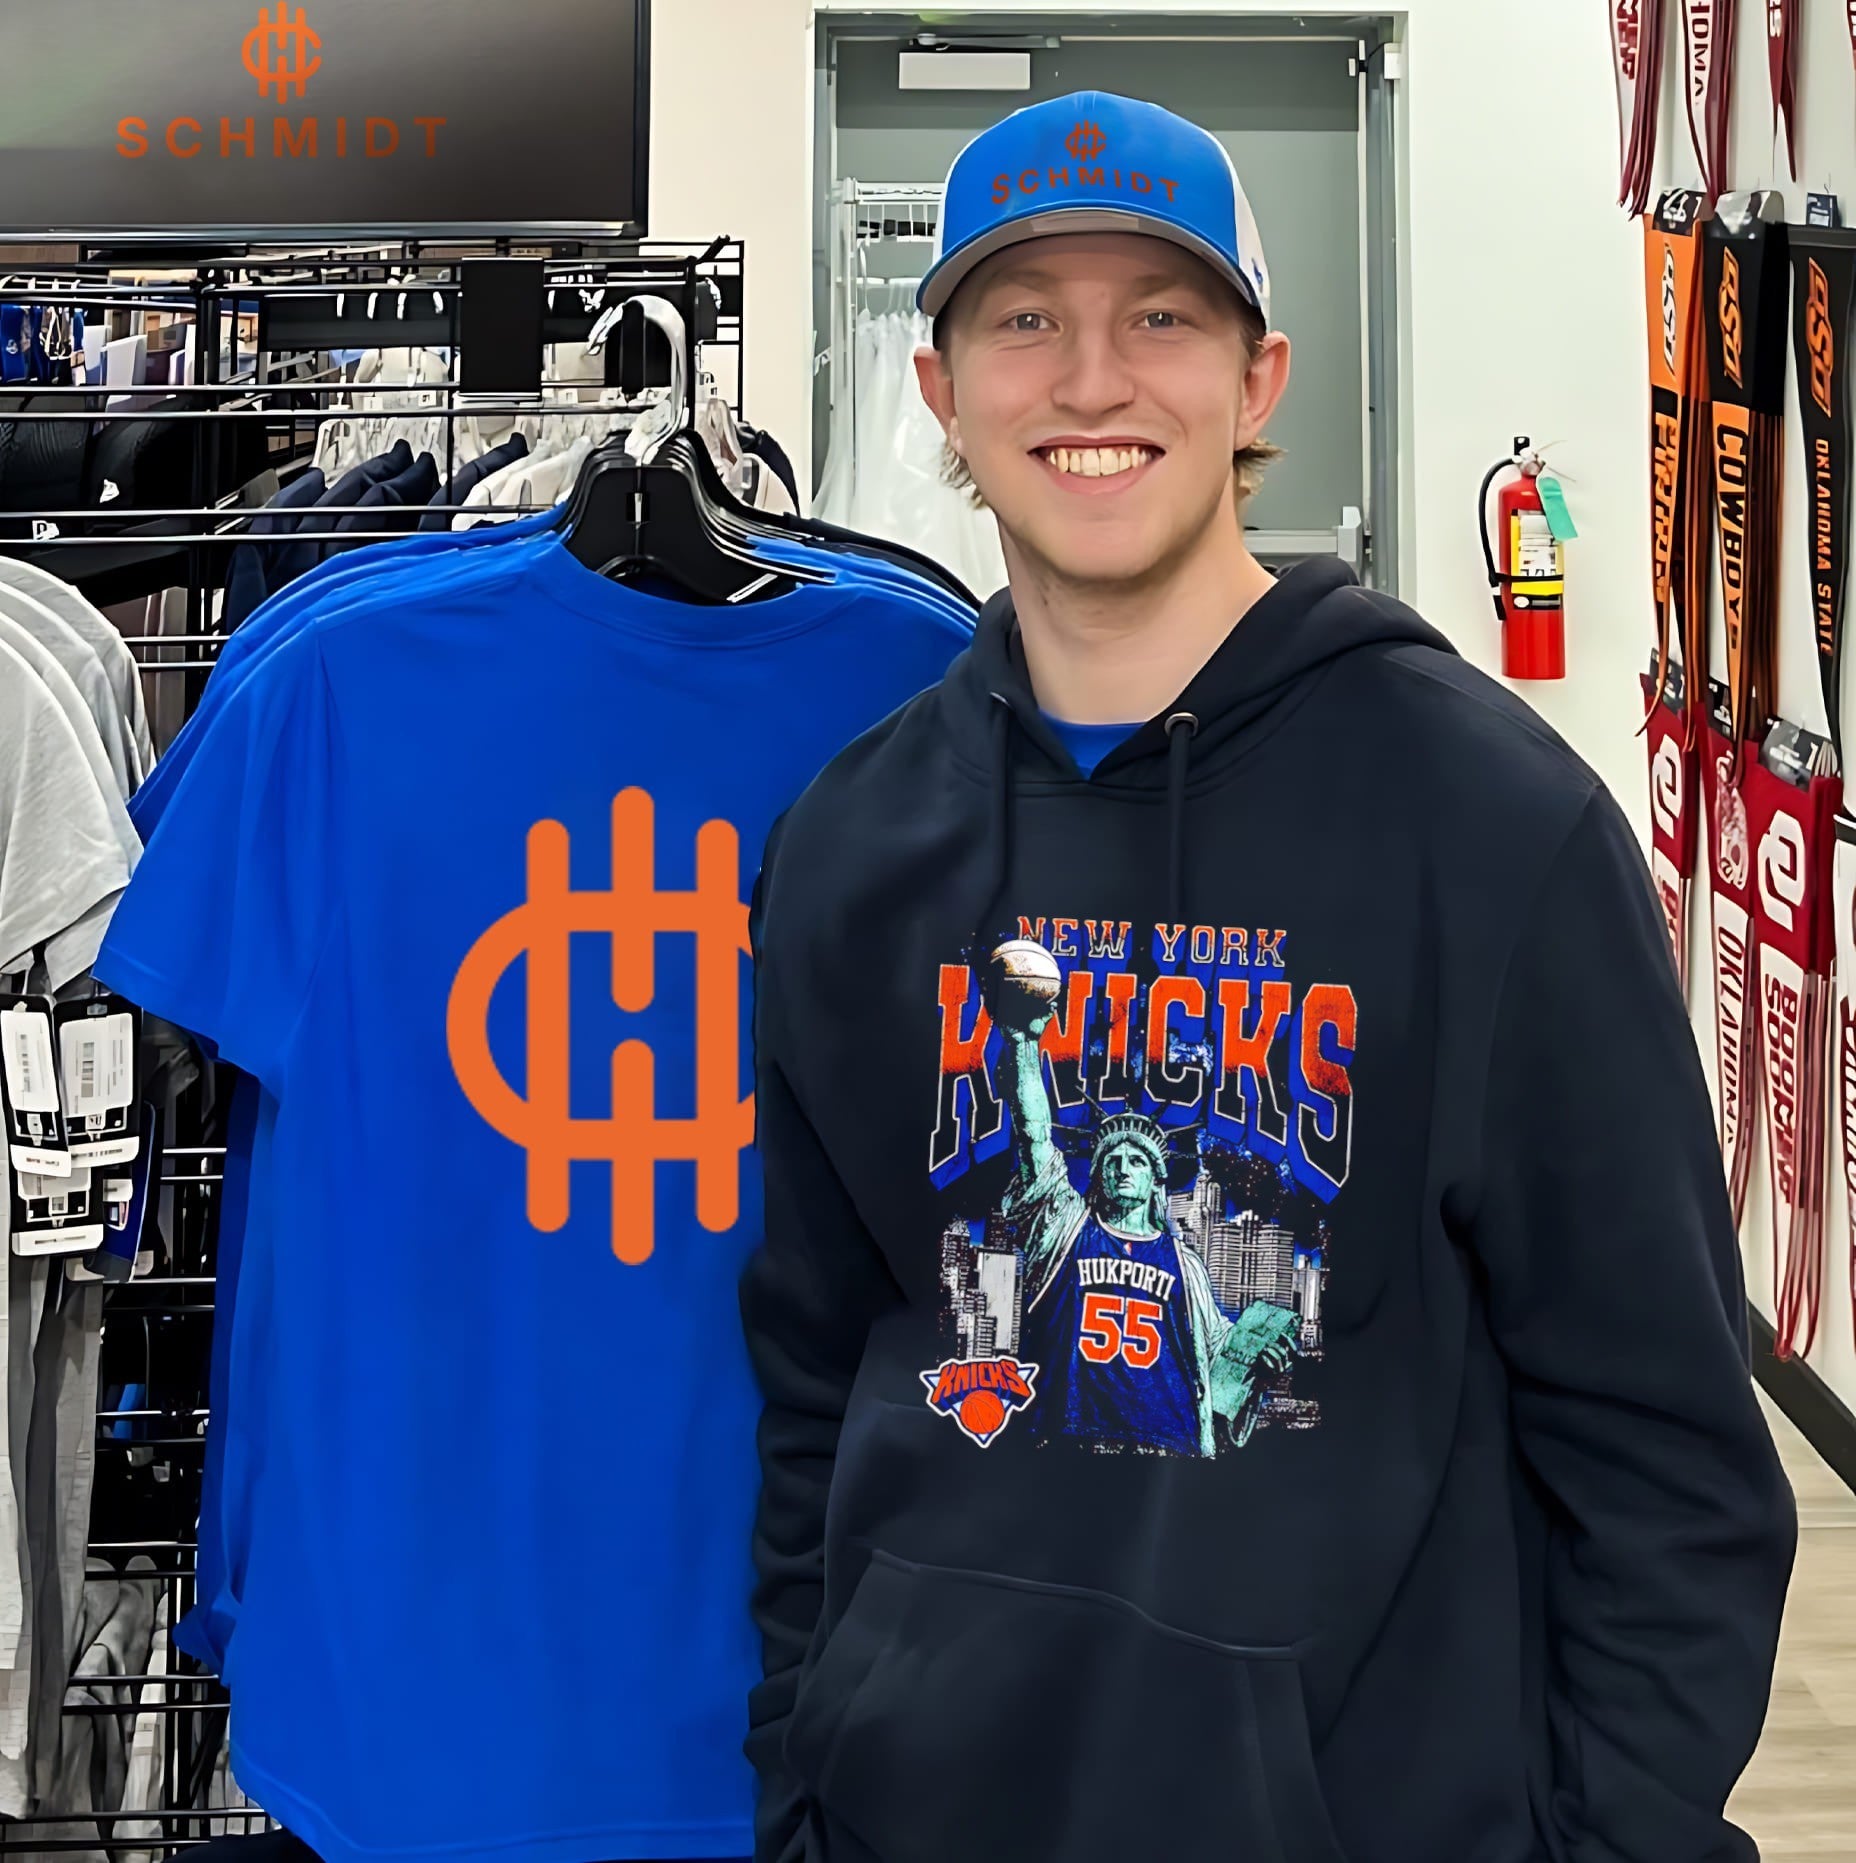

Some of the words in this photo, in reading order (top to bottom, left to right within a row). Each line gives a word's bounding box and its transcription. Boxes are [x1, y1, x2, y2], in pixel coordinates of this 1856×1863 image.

[116, 117, 448, 158] SCHMIDT
[991, 167, 1179, 205] SCHMIDT
[1017, 914, 1133, 961] NEW
[1155, 923, 1288, 969] YORK
[1718, 926, 1745, 1145] OKLAHOMA
[929, 962, 1358, 1190] KNICKS
[1077, 1256, 1175, 1301] HUKPORTI
[1078, 1292, 1164, 1370] 55
[931, 1360, 1032, 1405] KNICKS
